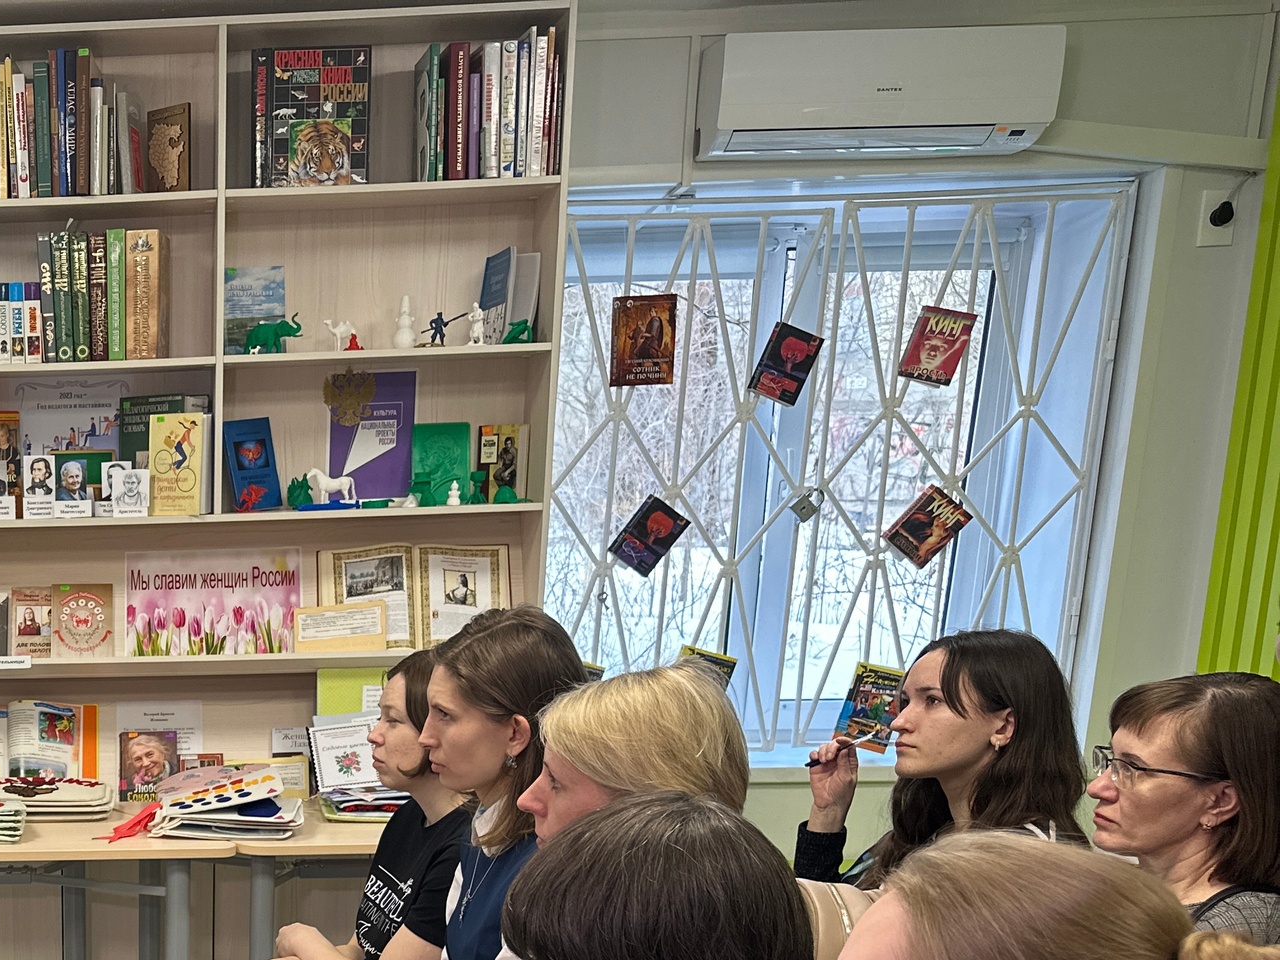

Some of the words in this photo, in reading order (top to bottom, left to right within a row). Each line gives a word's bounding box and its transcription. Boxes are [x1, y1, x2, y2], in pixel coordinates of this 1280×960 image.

[275, 50, 322, 69] КРАСНАЯ
[322, 67, 352, 84] КНИГА
[67, 80, 75, 113] АТЛАС
[322, 83, 367, 102] РОССИИ
[67, 127, 75, 156] МИРА
[14, 308, 22, 335] РЫБЫ
[925, 315, 973, 340] КИНГ
[632, 365, 660, 373] СОТНИК
[908, 363, 952, 383] ЯРОСТЬ
[361, 420, 395, 430] НАЦИОНАЛЬНЫЕ
[378, 438, 395, 446] РОССИИ
[925, 496, 967, 529] КИНГ
[130, 569, 150, 591] Мы
[153, 573, 197, 591] славим
[200, 572, 248, 594] женщин
[252, 566, 295, 588] России
[322, 744, 348, 752] Садовые
